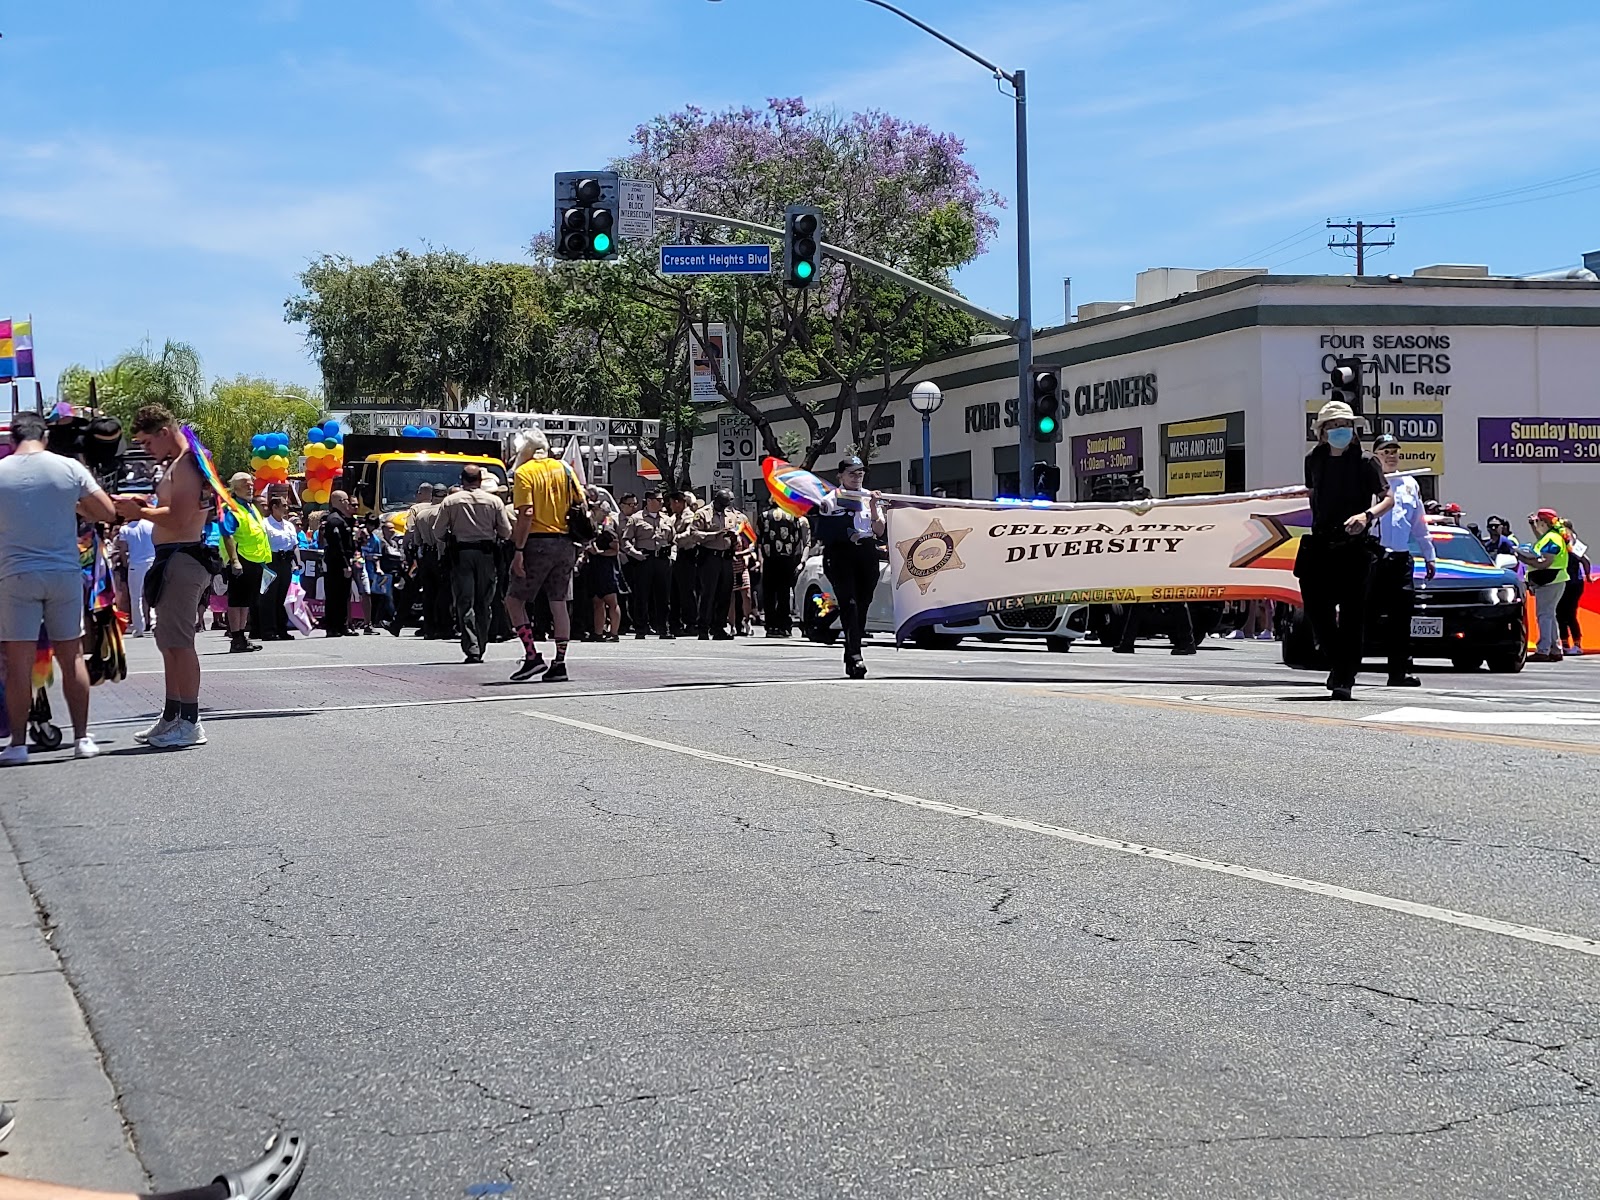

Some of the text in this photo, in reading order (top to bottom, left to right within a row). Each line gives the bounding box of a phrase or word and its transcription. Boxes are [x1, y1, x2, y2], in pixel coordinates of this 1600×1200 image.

[627, 193, 646, 202] DO NOT
[628, 201, 644, 210] BLOCK
[620, 210, 652, 219] INTERSECTION
[663, 253, 768, 268] Crescent Heights Blvd
[1320, 335, 1451, 349] FOUR SEASONS
[1074, 373, 1159, 417] CLEANERS
[1390, 381, 1404, 396] In
[1413, 381, 1452, 396] Rear
[965, 402, 1001, 434] FOUR
[723, 429, 751, 437] LIMIT
[1399, 419, 1438, 437] FOLD
[1511, 421, 1566, 441] Sunday
[721, 439, 754, 457] 30
[1086, 435, 1126, 454] Sunday Hours
[1169, 437, 1225, 458] WASH AND FOLD
[1491, 442, 1559, 458] 11:00am
[1080, 456, 1106, 471] 11:00am
[1110, 453, 1134, 470] 3:00pm
[1170, 472, 1178, 480] Let
[1185, 471, 1191, 479] do
[1191, 471, 1203, 480] your
[1203, 468, 1223, 479] Laundry
[988, 522, 1216, 538] CELEBRATING
[1005, 537, 1185, 563] DIVERSITY
[986, 586, 1226, 613] ALEX VILLANUEVA, SHERIFF
